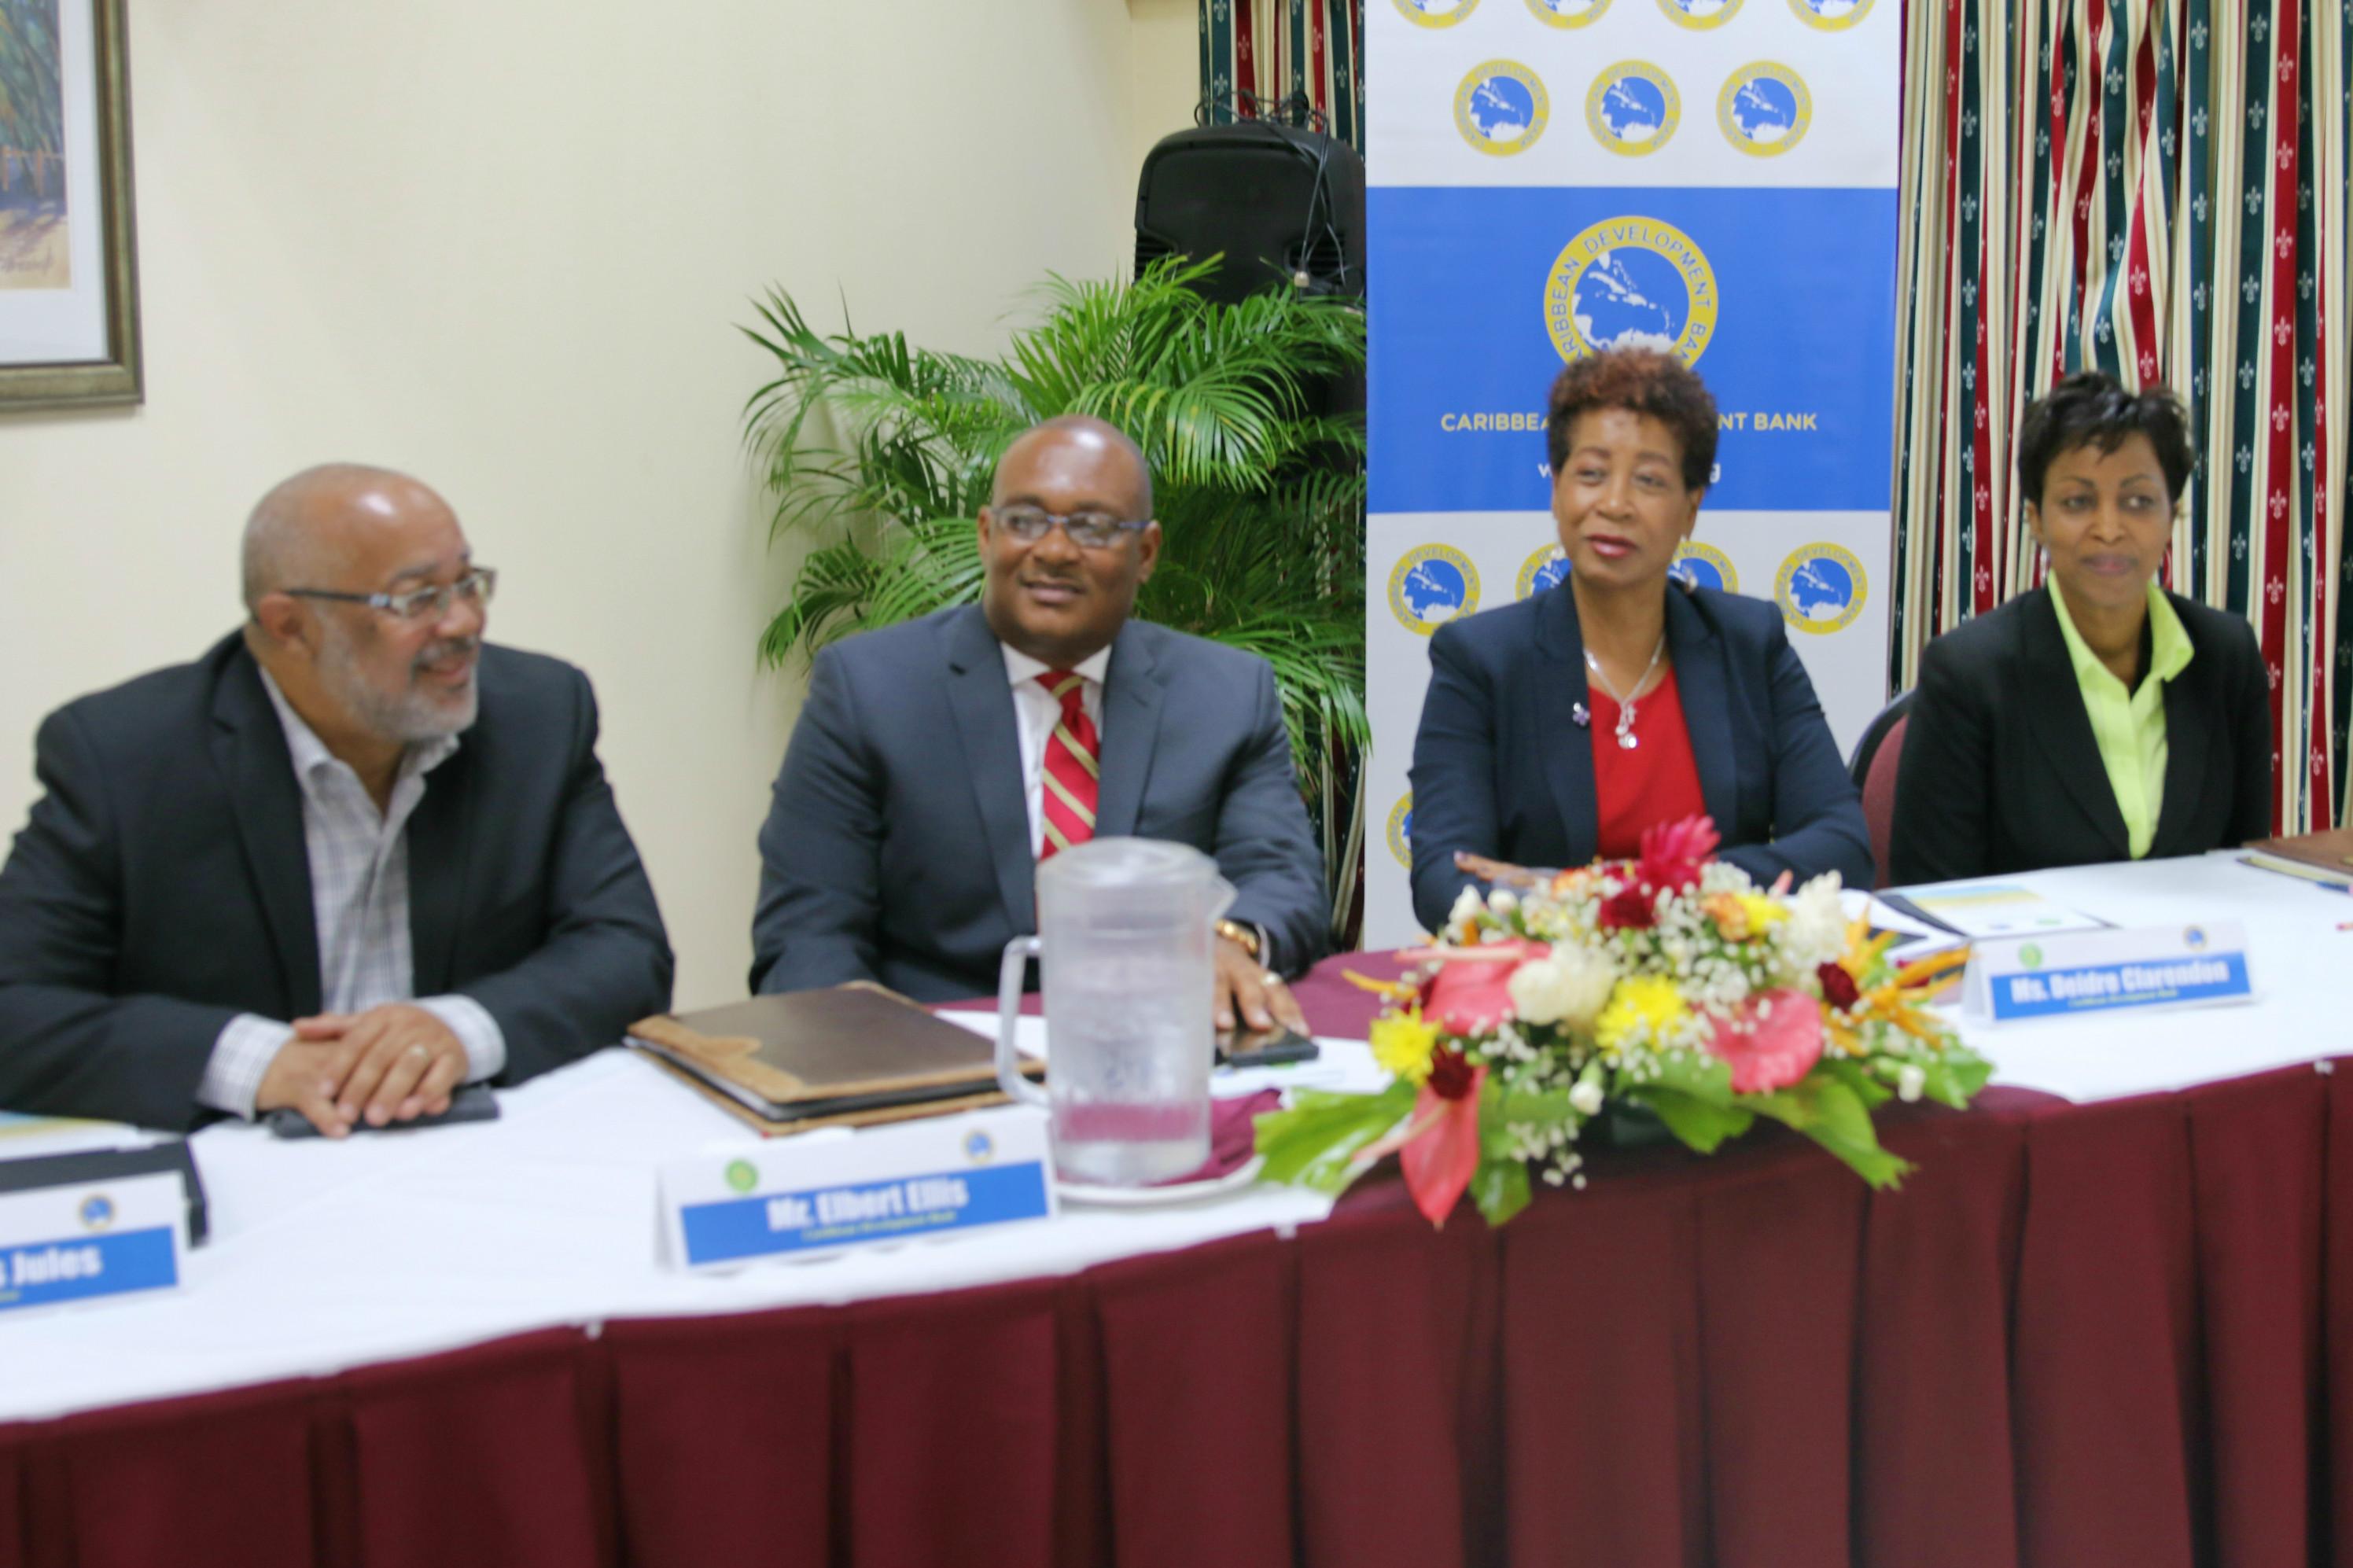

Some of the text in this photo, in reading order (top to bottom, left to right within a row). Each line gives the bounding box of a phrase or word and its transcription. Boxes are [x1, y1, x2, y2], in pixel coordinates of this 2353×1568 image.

[1552, 225, 1710, 359] RIBBEAN DEVELOPMENT BAN
[1441, 412, 1549, 431] CARIBBEA
[1754, 412, 1817, 431] BANK
[1674, 546, 1736, 591] EVELOPMENT
[2010, 977, 2049, 1004] Ms.
[2049, 970, 2121, 1000] Deidre
[2121, 959, 2230, 992] Clarendon
[766, 1198, 815, 1232] Mr.
[906, 1176, 970, 1213] Ellis
[13, 1246, 104, 1286] Jules
